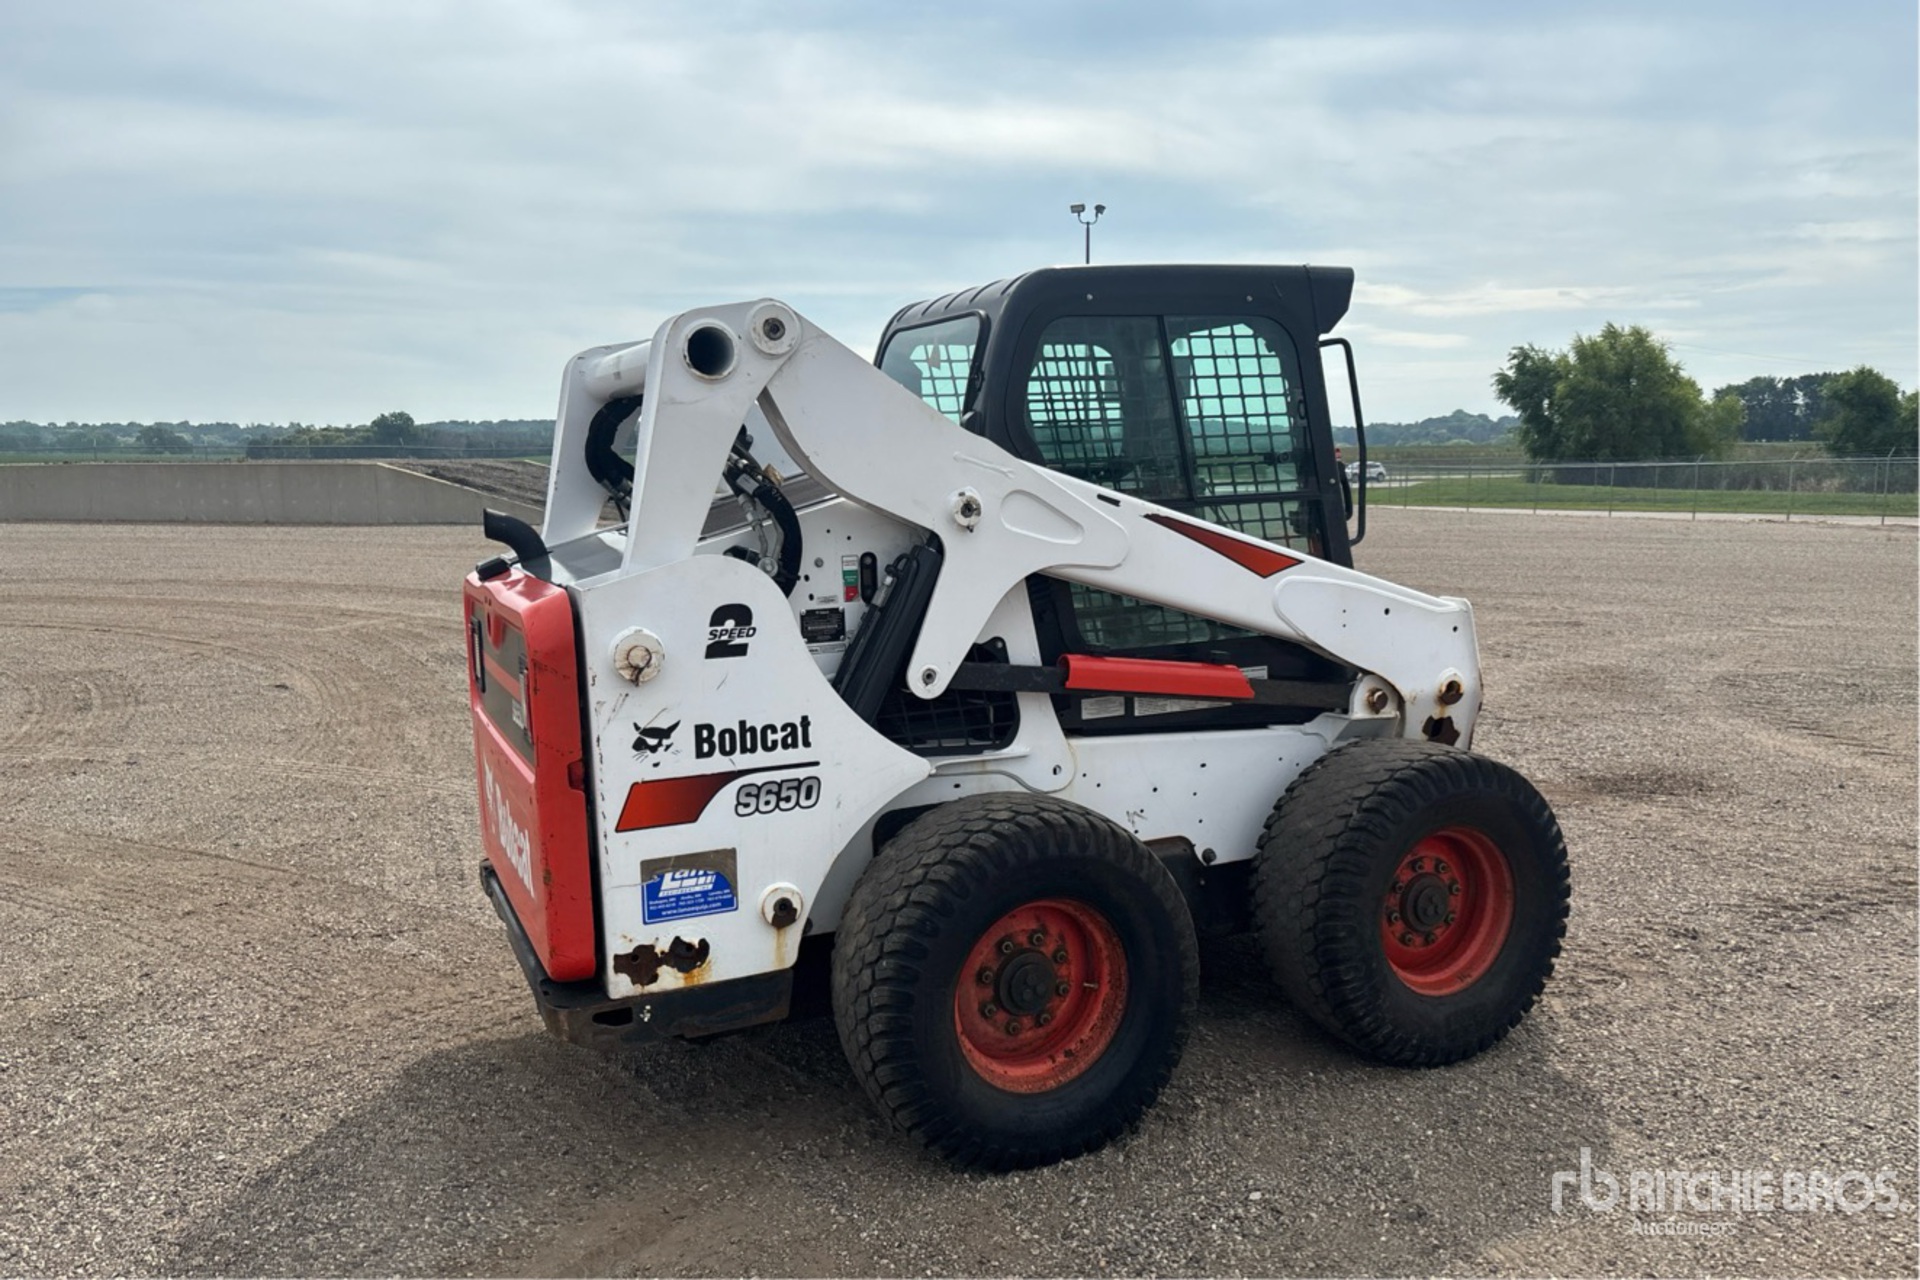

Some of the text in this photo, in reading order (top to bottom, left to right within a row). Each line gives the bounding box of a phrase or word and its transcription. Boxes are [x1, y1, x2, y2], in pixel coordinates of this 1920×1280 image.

[705, 603, 754, 660] 2
[707, 626, 757, 641] SPEED
[693, 715, 812, 760] Bobcat
[735, 776, 821, 817] S650
